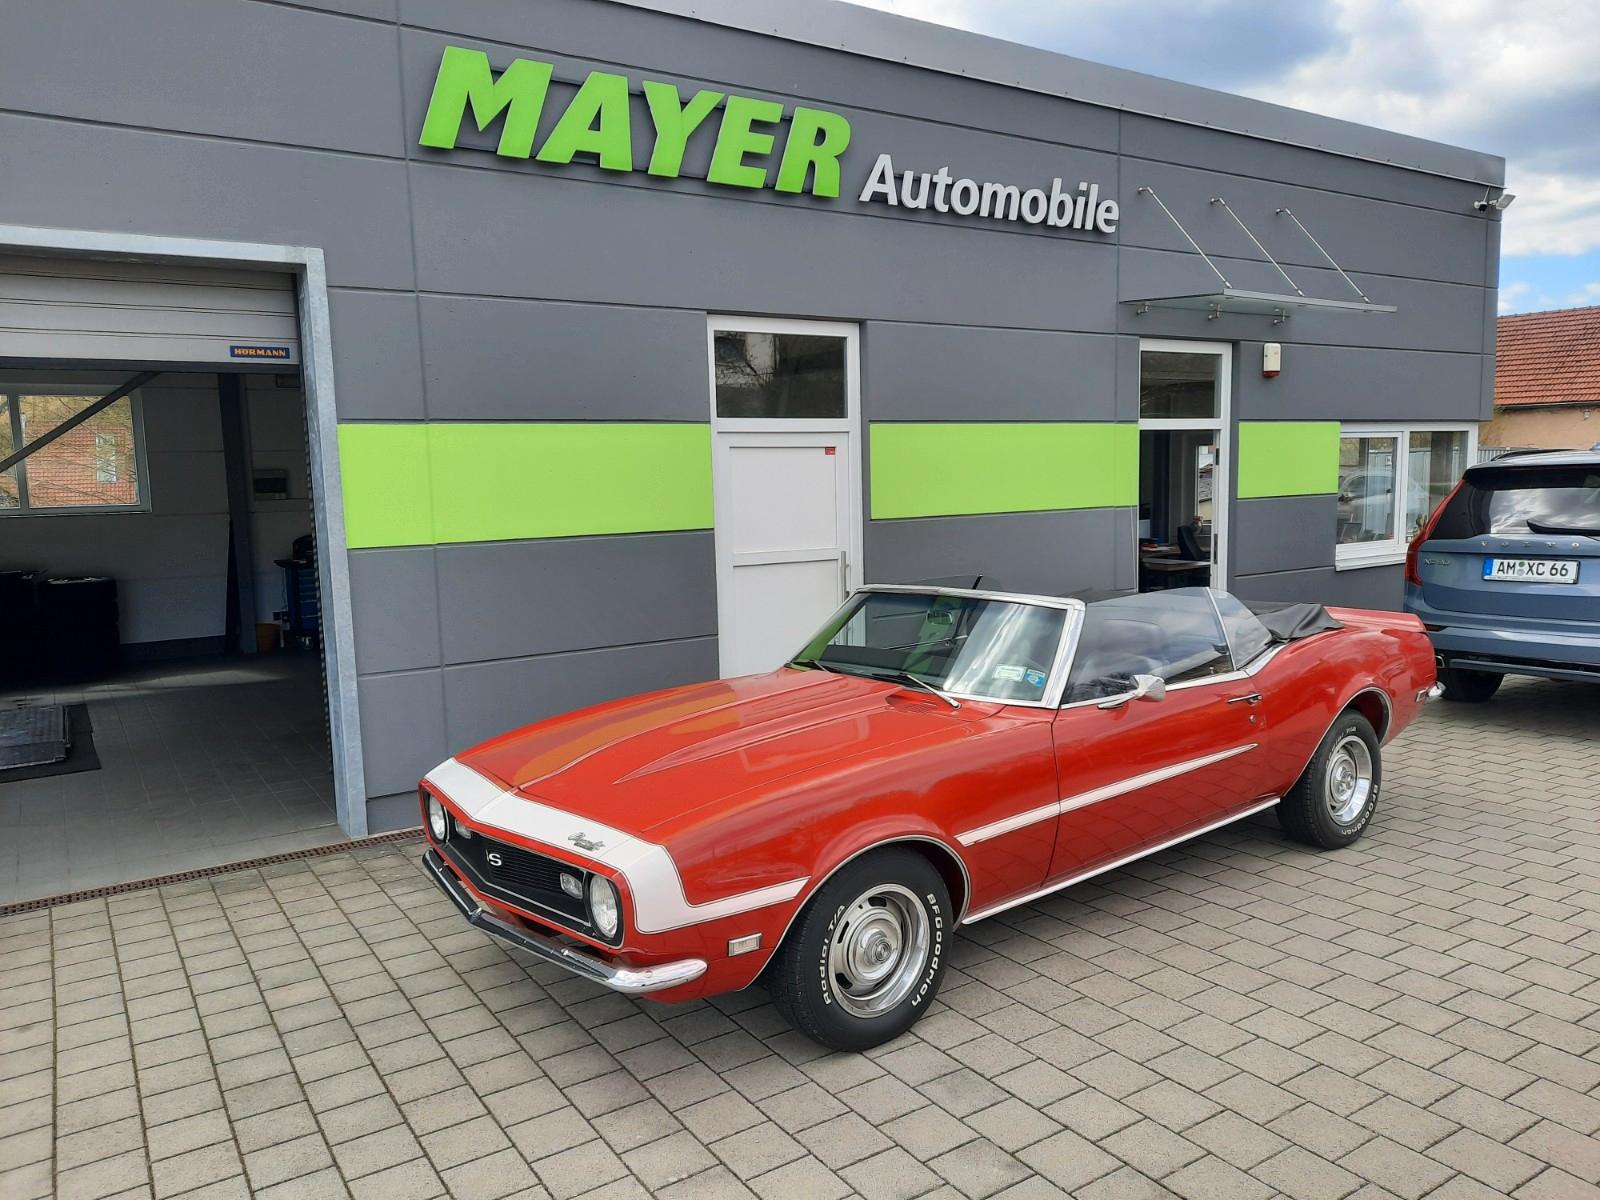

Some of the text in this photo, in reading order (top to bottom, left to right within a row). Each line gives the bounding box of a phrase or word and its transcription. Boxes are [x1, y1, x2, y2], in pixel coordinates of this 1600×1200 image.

[419, 46, 1119, 233] MAYER Automobile
[1497, 562, 1568, 577] AM XC 66
